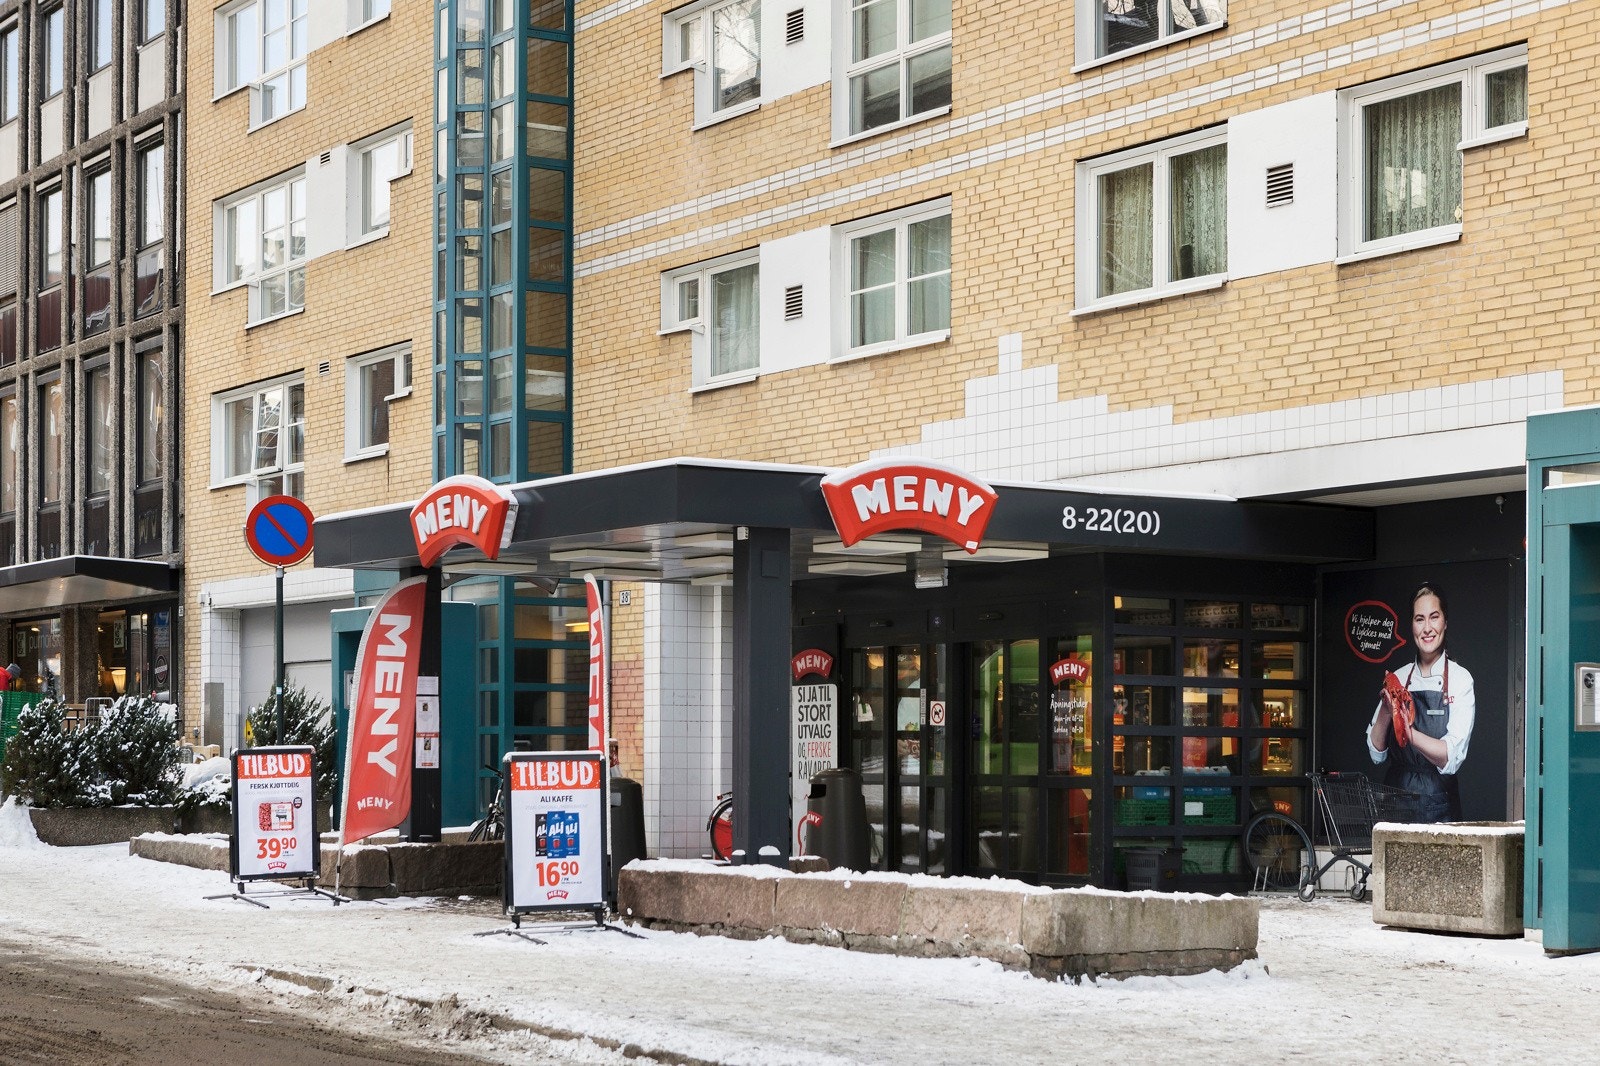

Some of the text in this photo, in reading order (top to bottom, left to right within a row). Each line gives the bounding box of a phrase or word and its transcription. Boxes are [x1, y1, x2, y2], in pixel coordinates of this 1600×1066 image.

[851, 476, 985, 526] MENY
[415, 494, 489, 545] MENY
[1062, 506, 1161, 535] 8-22(20)
[1360, 614, 1381, 627] hjelper
[1383, 618, 1393, 631] deg
[1356, 626, 1377, 640] lykkes
[1378, 630, 1392, 639] med
[796, 654, 829, 673] MENY
[1054, 663, 1086, 679] MENY
[367, 613, 412, 778] MENY
[797, 686, 831, 702] SI JA TIL
[1050, 694, 1088, 712] Åpningstider
[797, 704, 832, 722] STORT
[797, 723, 832, 739] UTVALG
[797, 741, 832, 758] OG FERSKE
[241, 754, 306, 776] TILBUD
[516, 761, 594, 786] TILBUD
[357, 796, 394, 811] MENY
[548, 890, 568, 899] MENY
